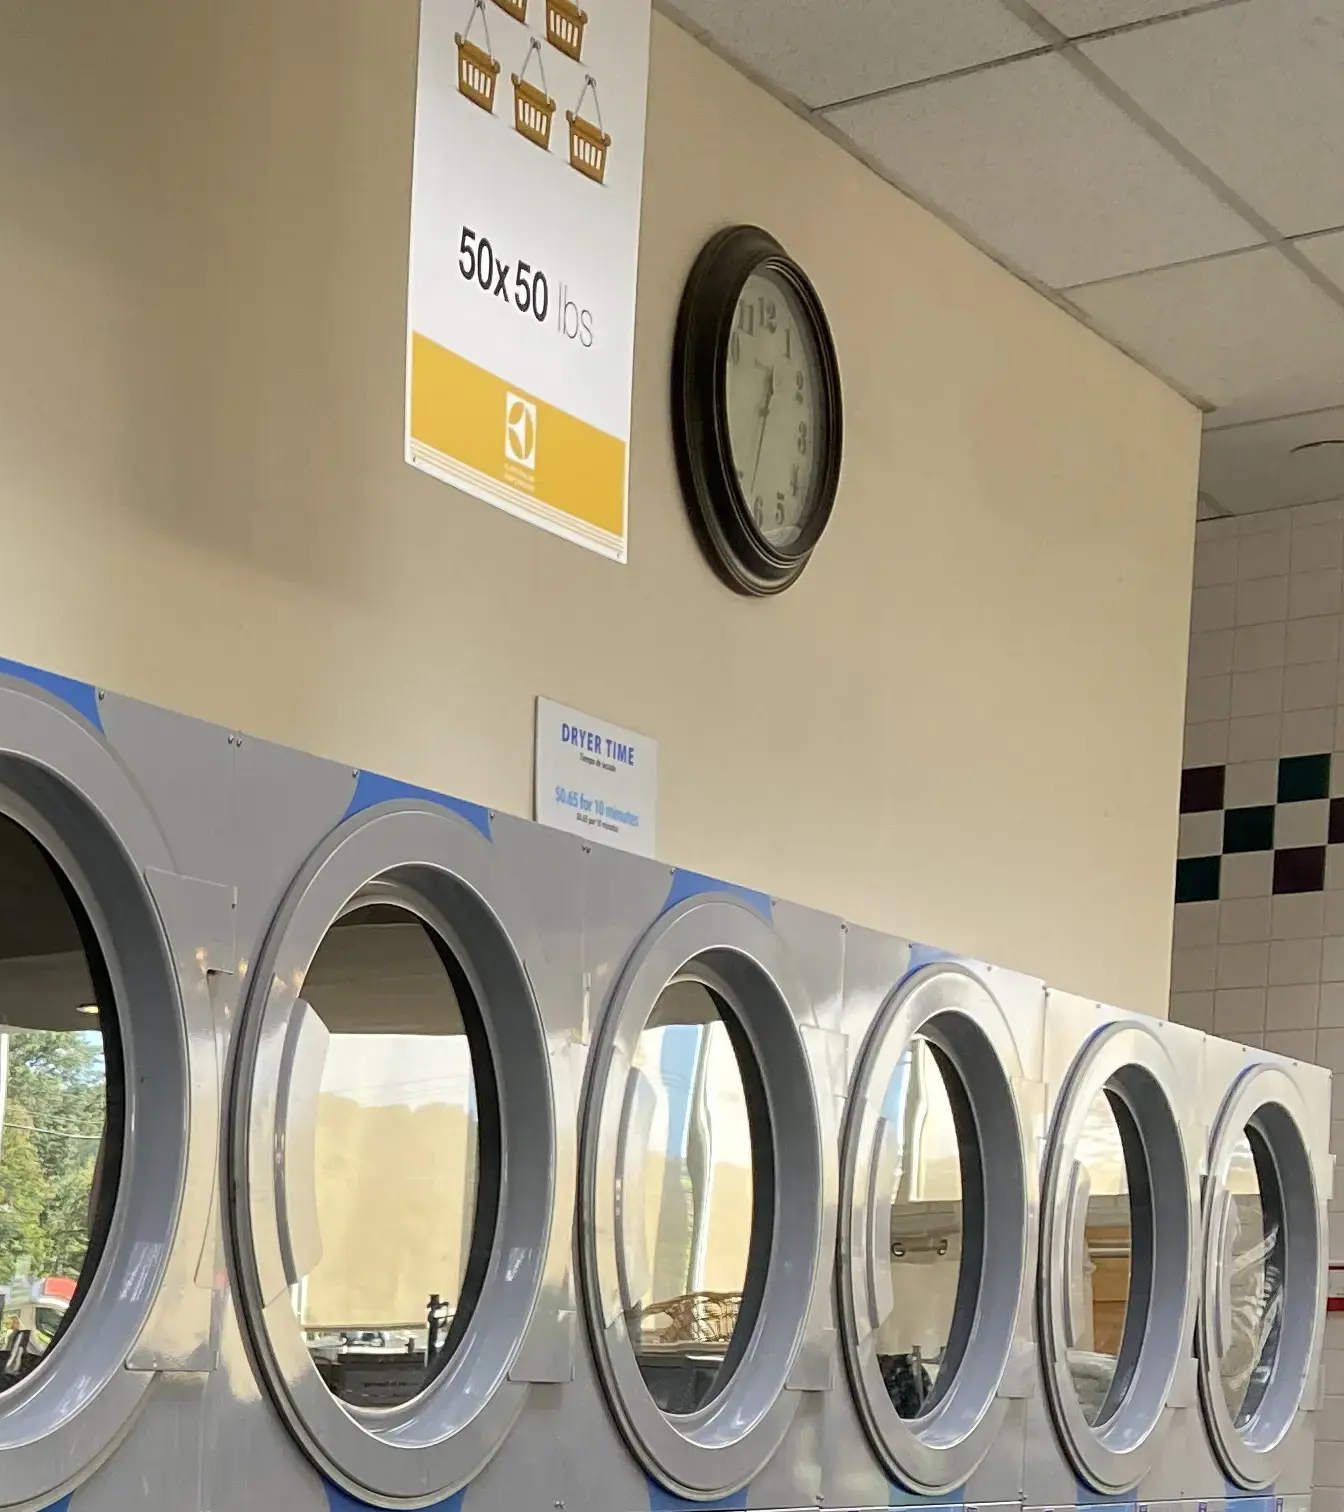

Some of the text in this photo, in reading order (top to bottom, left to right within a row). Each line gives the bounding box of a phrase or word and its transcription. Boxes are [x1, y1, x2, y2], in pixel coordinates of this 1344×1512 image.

[558, 281, 593, 348] lbs
[758, 297, 777, 334] 12
[798, 420, 807, 455] 3
[775, 490, 785, 526] 5
[561, 722, 635, 767] DRYER TIME
[579, 792, 593, 812] for
[594, 798, 604, 816] 10
[605, 805, 640, 828] minutes
